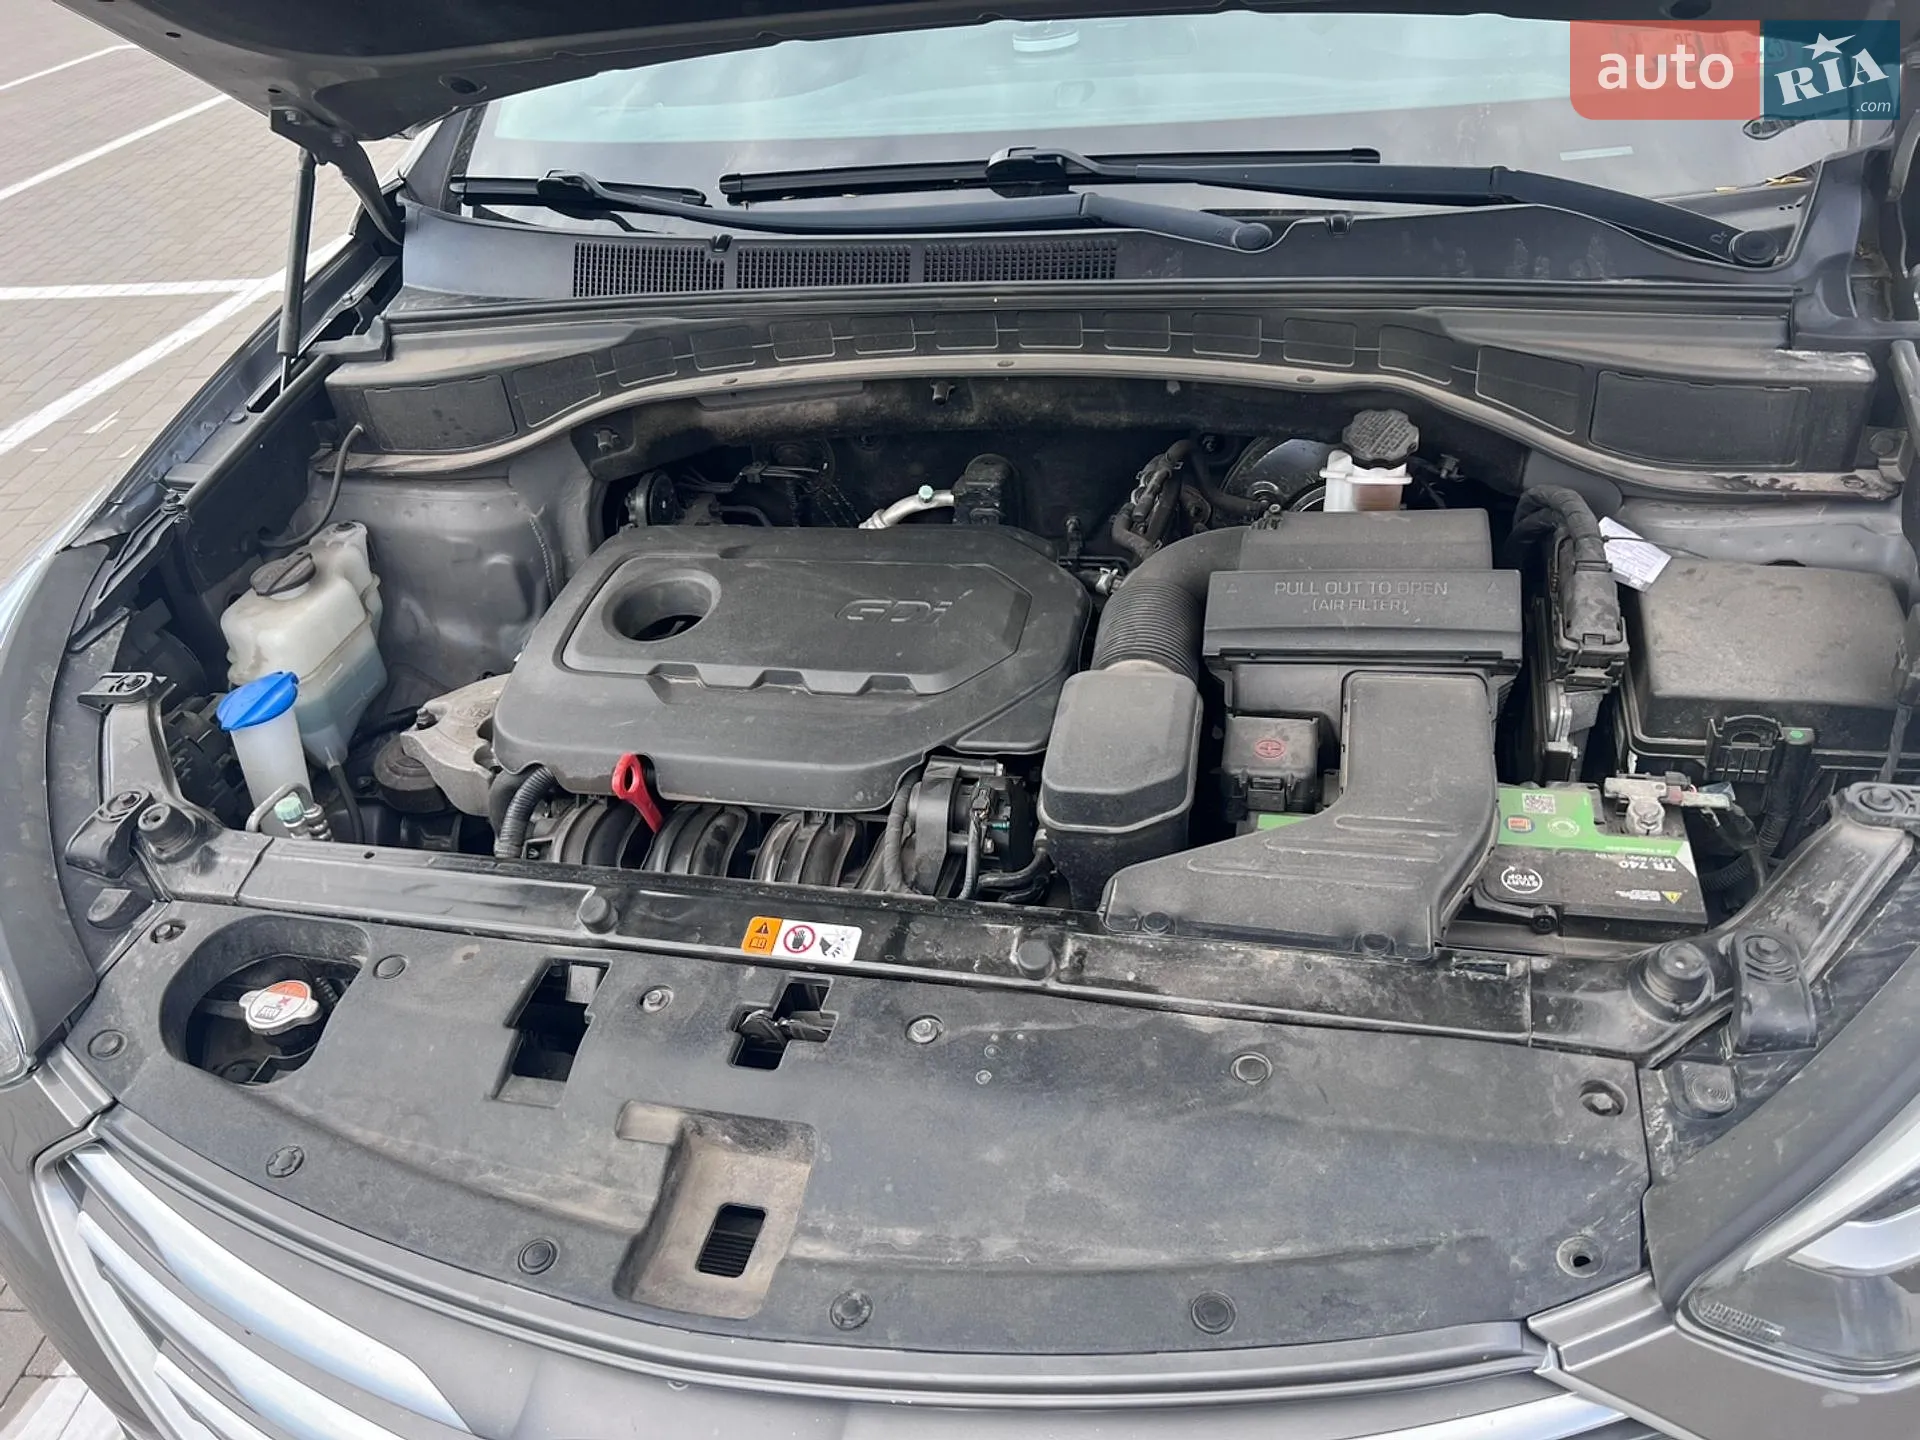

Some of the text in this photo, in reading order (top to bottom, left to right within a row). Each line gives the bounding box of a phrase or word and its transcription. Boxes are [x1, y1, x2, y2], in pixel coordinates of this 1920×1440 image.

[1275, 581, 1449, 596] PULL OUT TO OPEN
[1312, 598, 1409, 612] (AIR FILTER)
[1507, 879, 1539, 887] START
